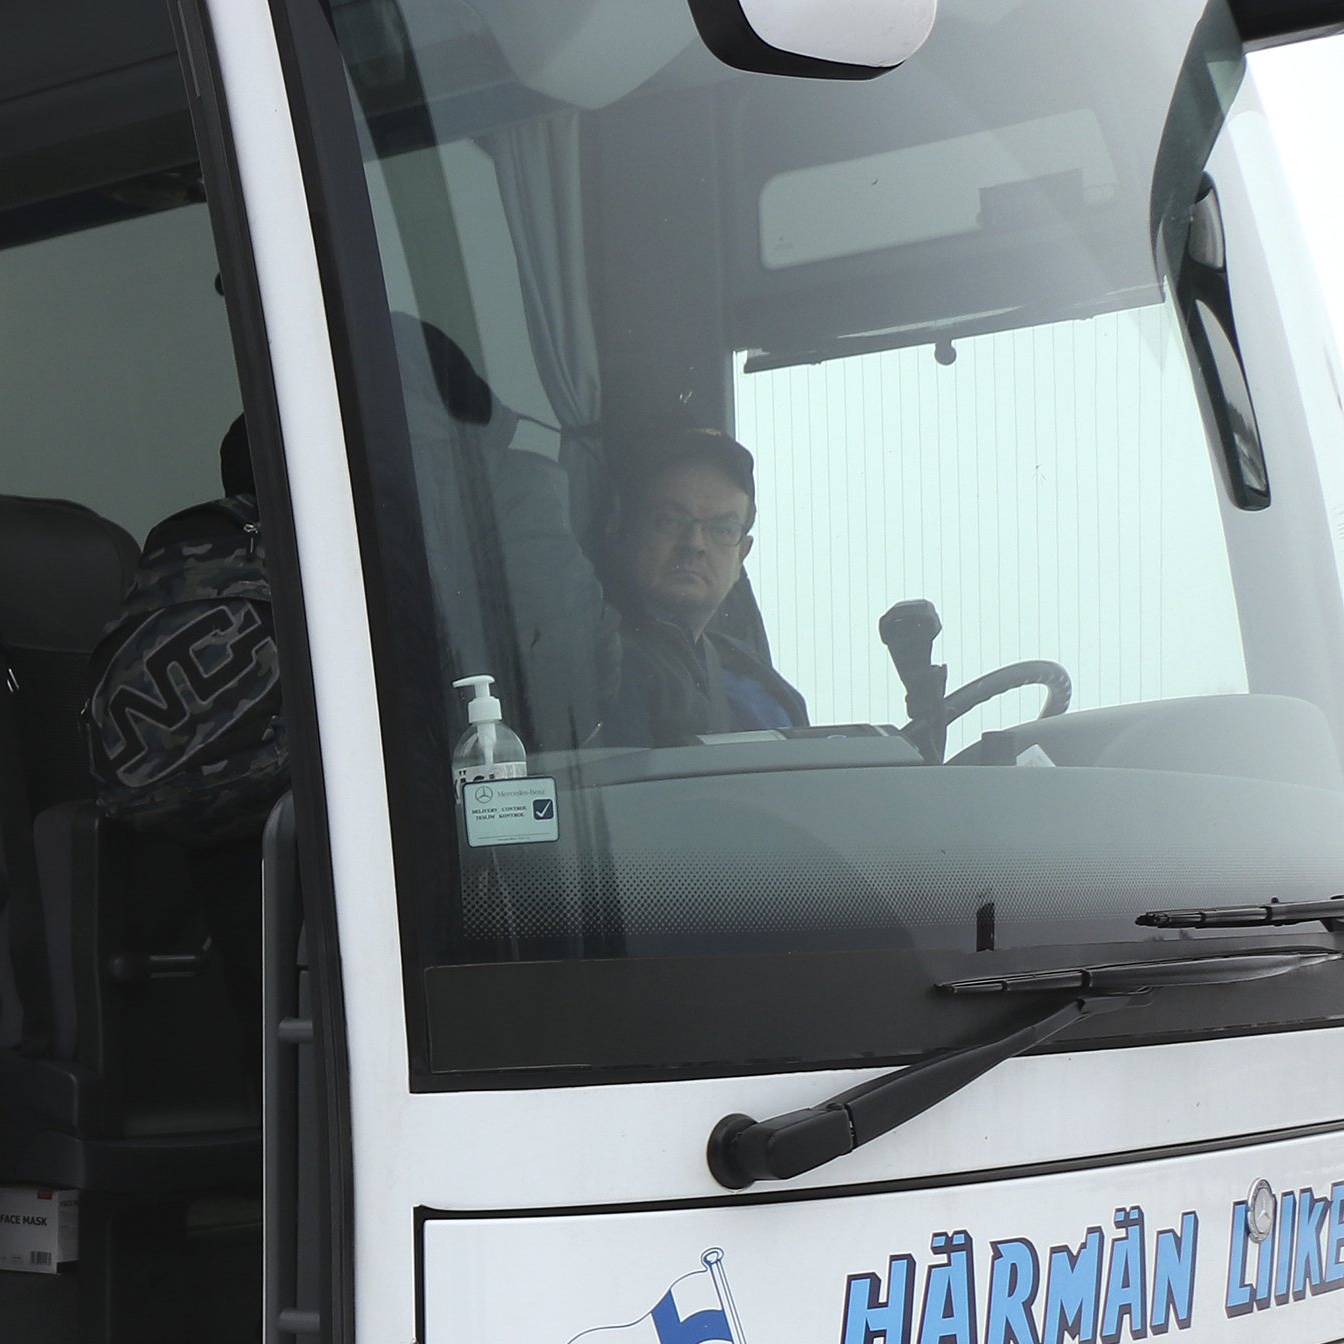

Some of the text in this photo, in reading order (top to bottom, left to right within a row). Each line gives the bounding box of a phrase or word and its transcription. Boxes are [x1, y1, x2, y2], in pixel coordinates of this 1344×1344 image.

[497, 788, 545, 798] Mercedes-Benz
[0, 1213, 48, 1227] FACE MASK
